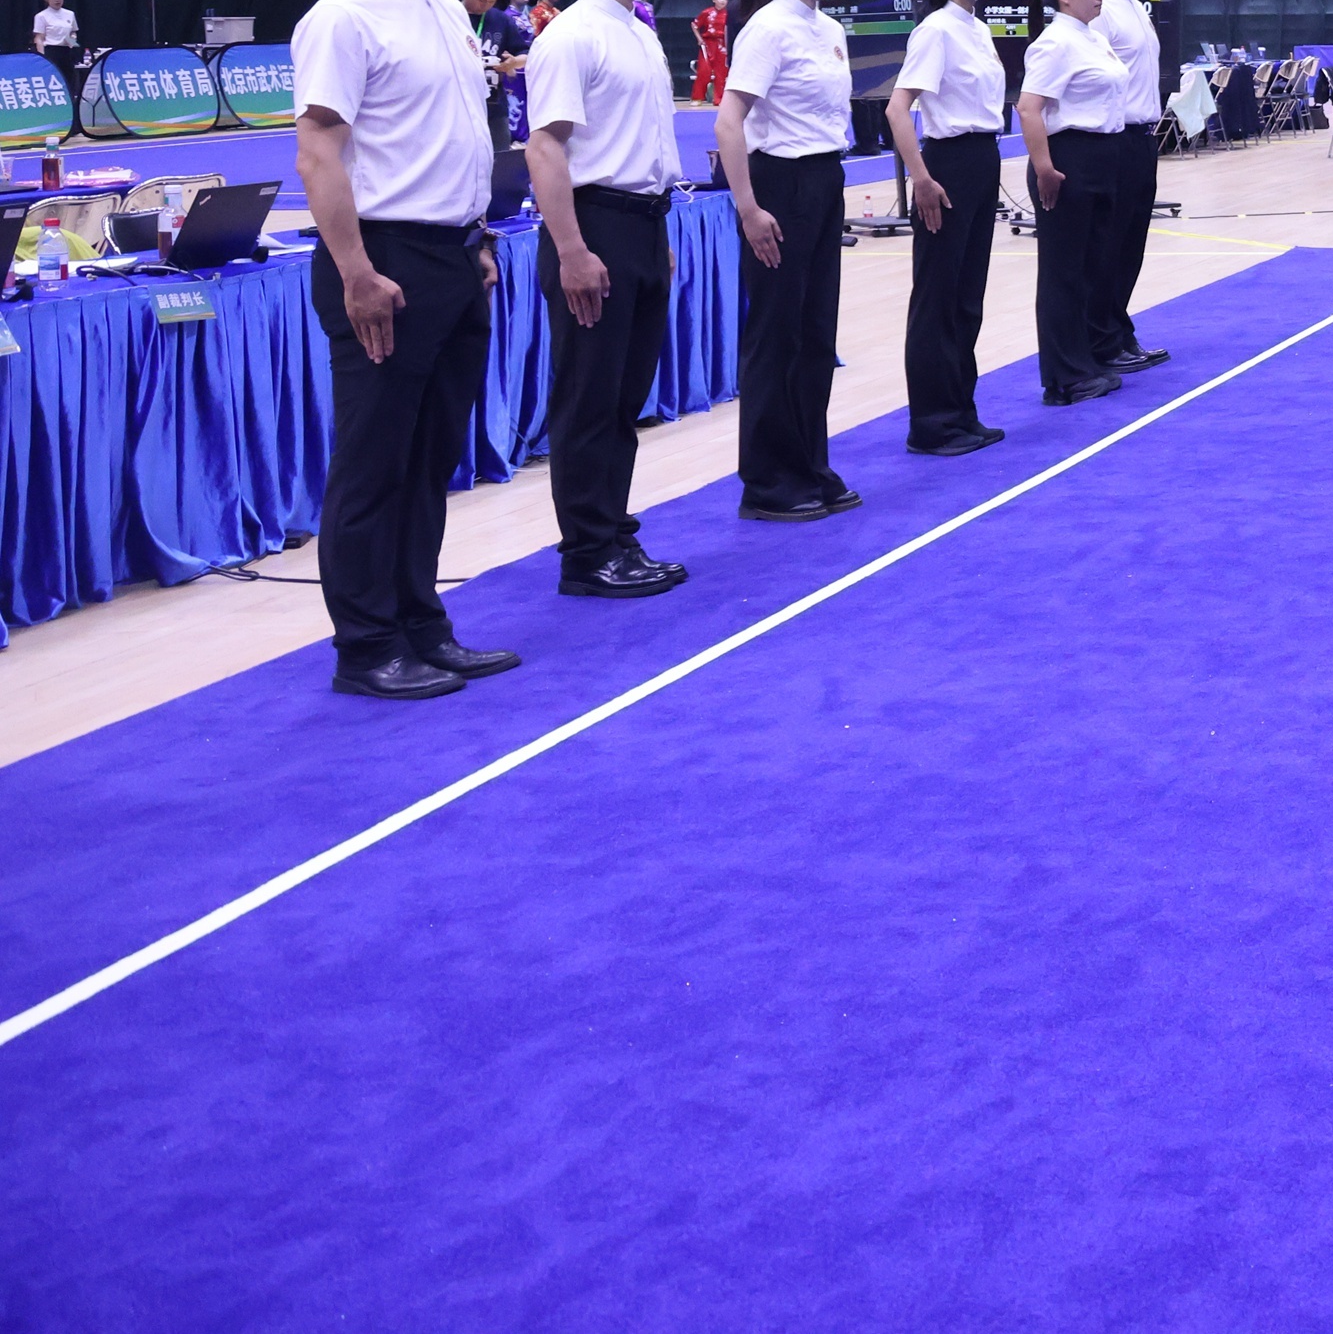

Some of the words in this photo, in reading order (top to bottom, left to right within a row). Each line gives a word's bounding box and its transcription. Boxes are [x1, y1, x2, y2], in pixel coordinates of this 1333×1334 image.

[104, 67, 214, 103] 北京市体育局
[155, 291, 206, 309] 副裁判长
